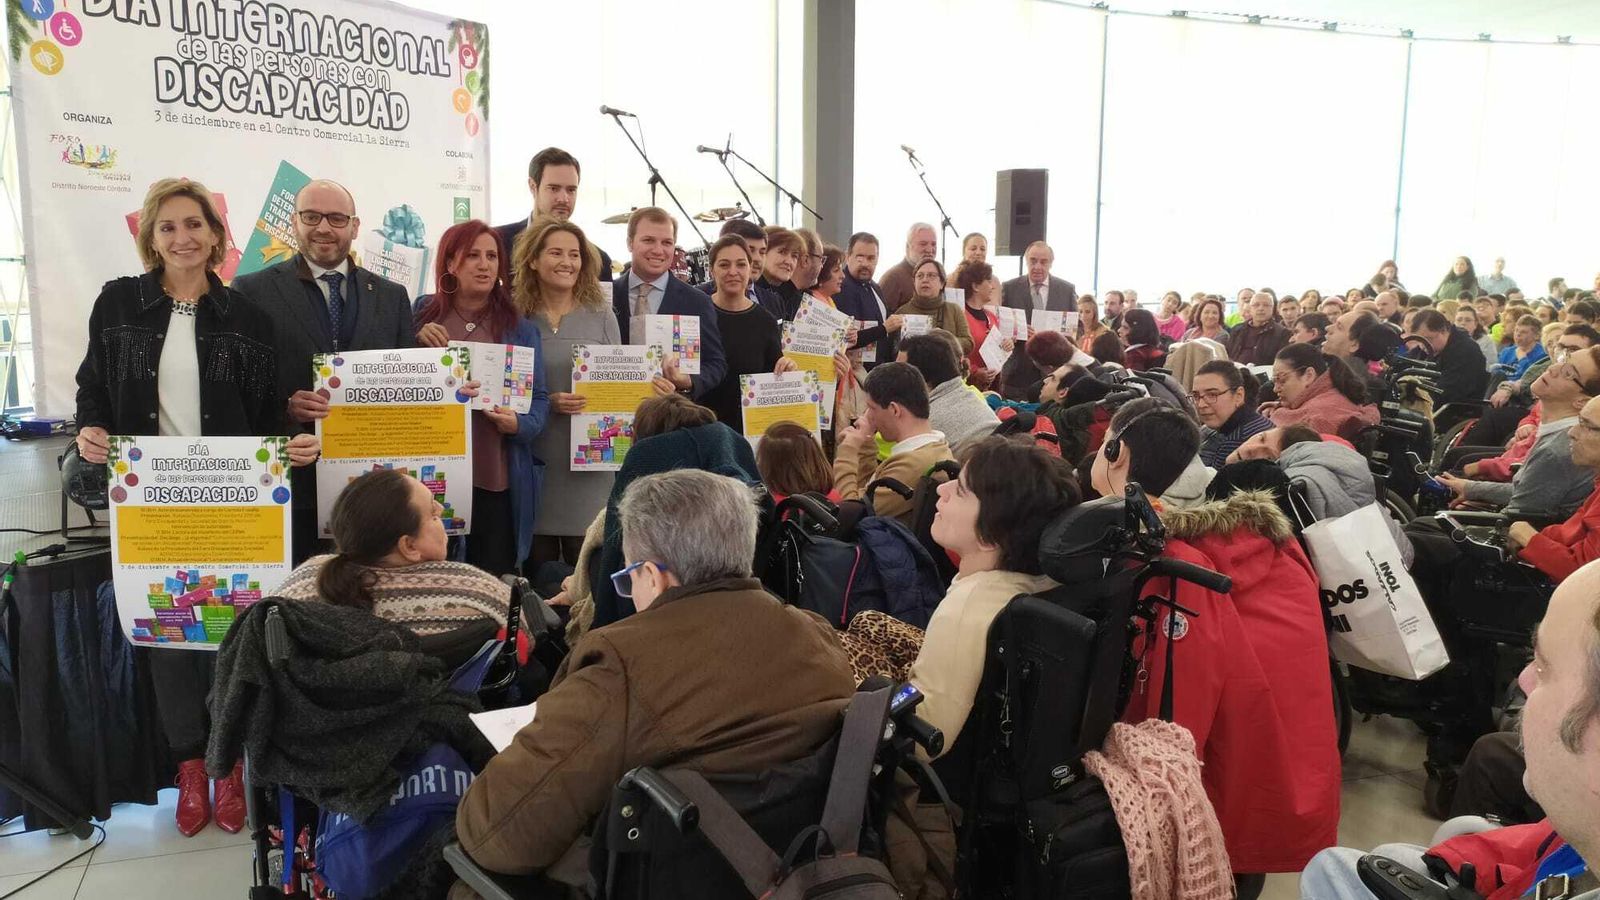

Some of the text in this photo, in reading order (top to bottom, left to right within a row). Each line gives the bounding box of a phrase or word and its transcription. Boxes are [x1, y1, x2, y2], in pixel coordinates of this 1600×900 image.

[177, 33, 391, 92] de las personas con
[154, 56, 410, 131] DISCAPACIDAD
[63, 111, 113, 125] ORGANIZA
[154, 110, 411, 149] 3 de diciembre en el Centro Comercial la Sierra
[49, 133, 81, 144] FORO
[269, 202, 293, 225] TRABA
[345, 386, 443, 403] DISCAPACIDAD
[187, 440, 209, 456] DÍA
[155, 474, 244, 484] de las personas con
[144, 486, 258, 503] DISCAPACIDAD
[1379, 561, 1401, 593] TONI
